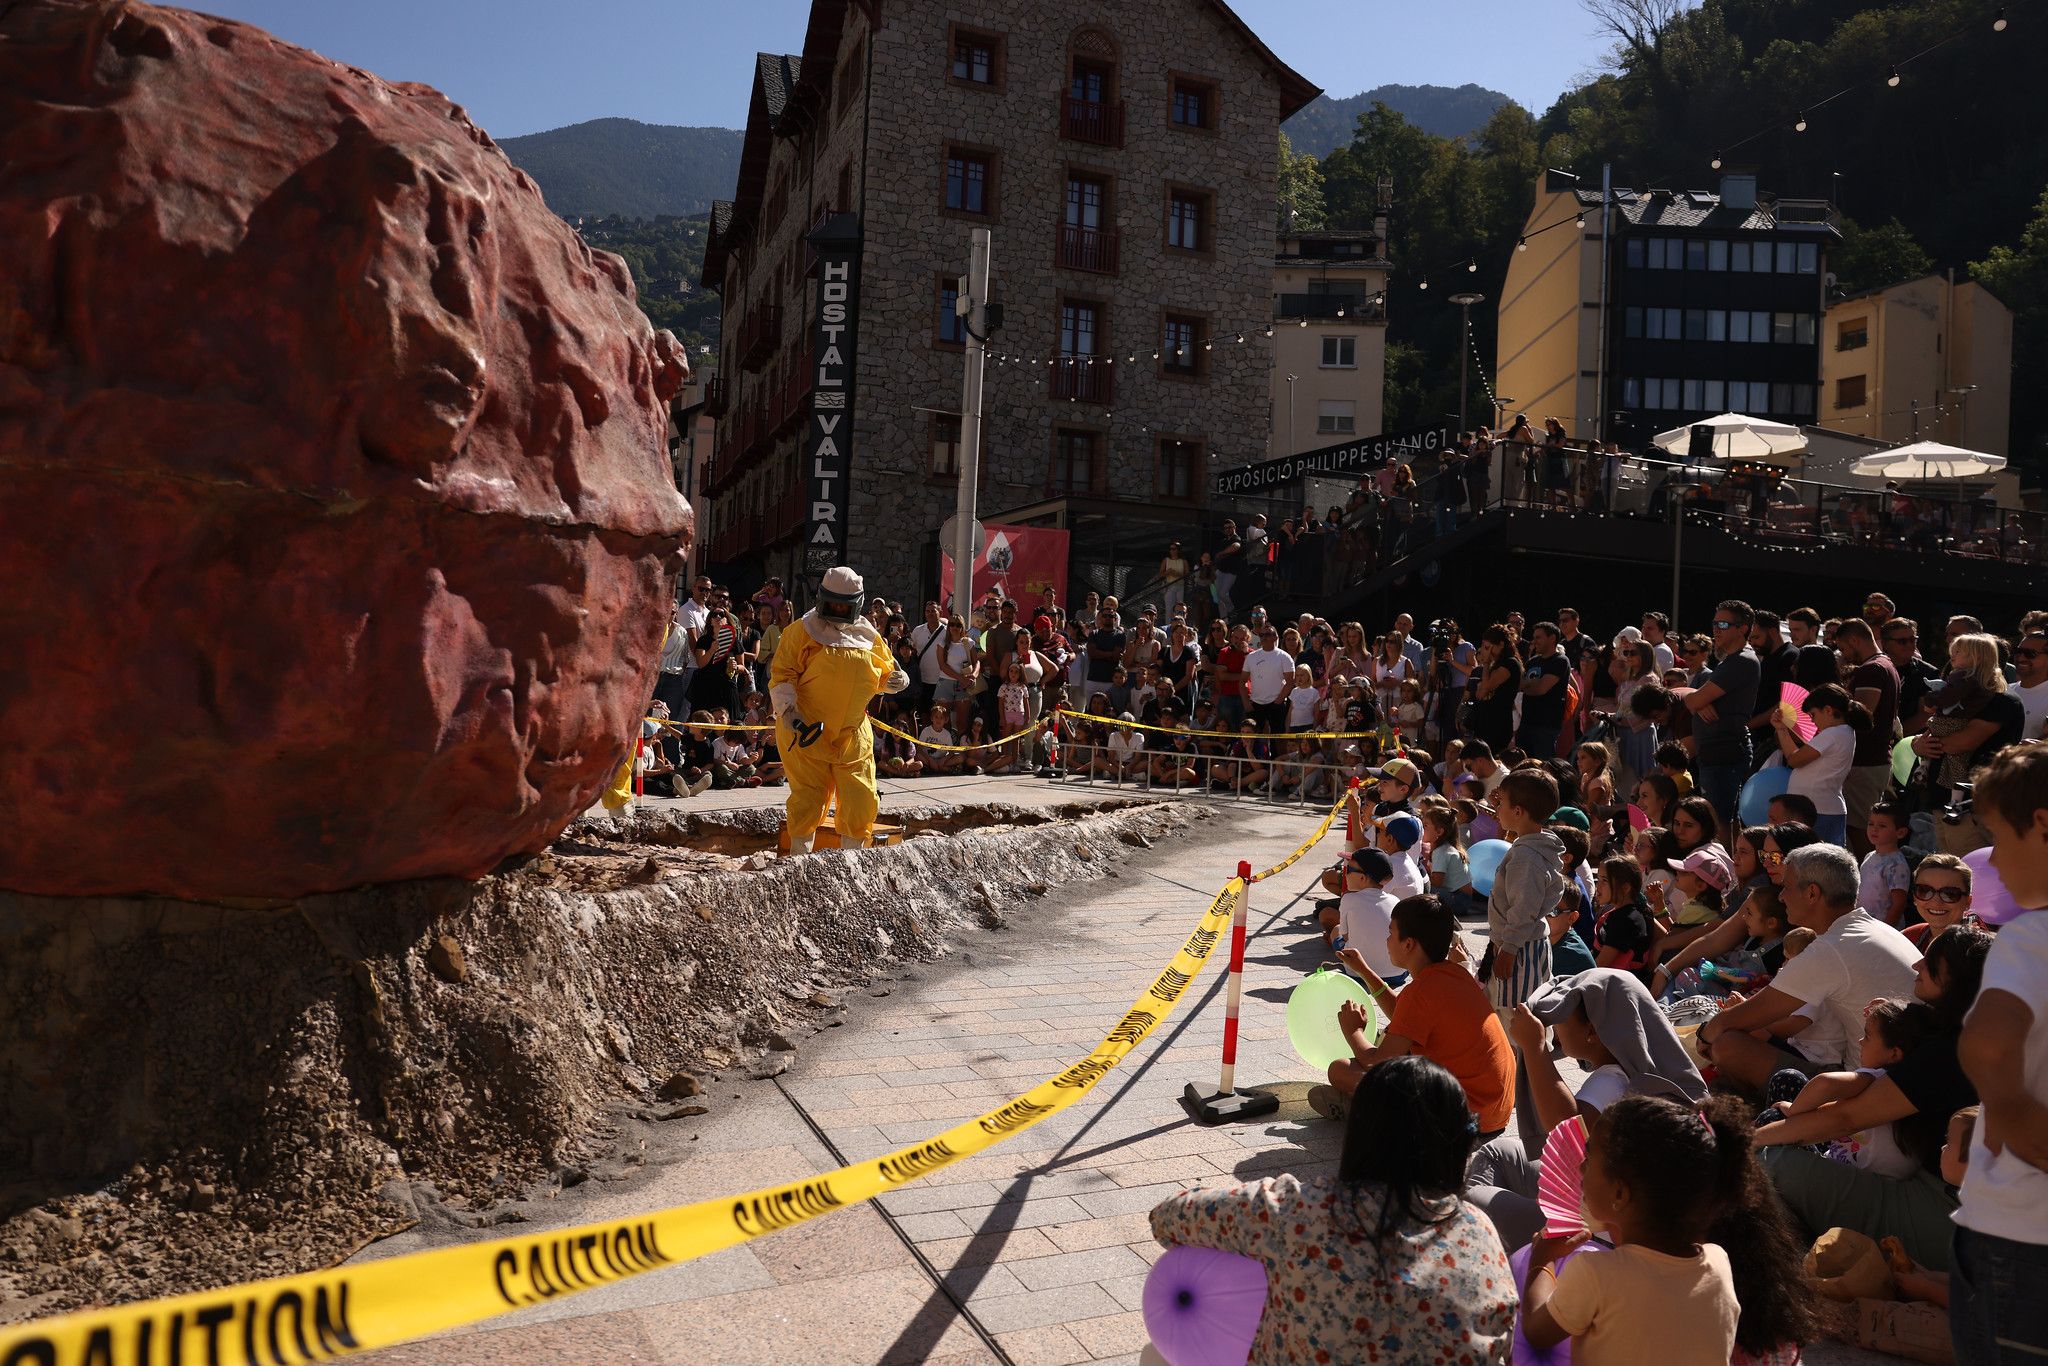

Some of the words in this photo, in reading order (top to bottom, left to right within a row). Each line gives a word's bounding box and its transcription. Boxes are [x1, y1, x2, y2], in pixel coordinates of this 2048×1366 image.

[819, 261, 849, 387] HOSTAL
[811, 415, 841, 544] VALIRA
[1218, 458, 1292, 493] EXPOSICIÓ
[1296, 446, 1368, 477] PHILIPPE
[494, 1222, 672, 1306] CAUTION
[733, 1180, 843, 1236] CAUTION
[878, 1140, 958, 1183] CAUTION
